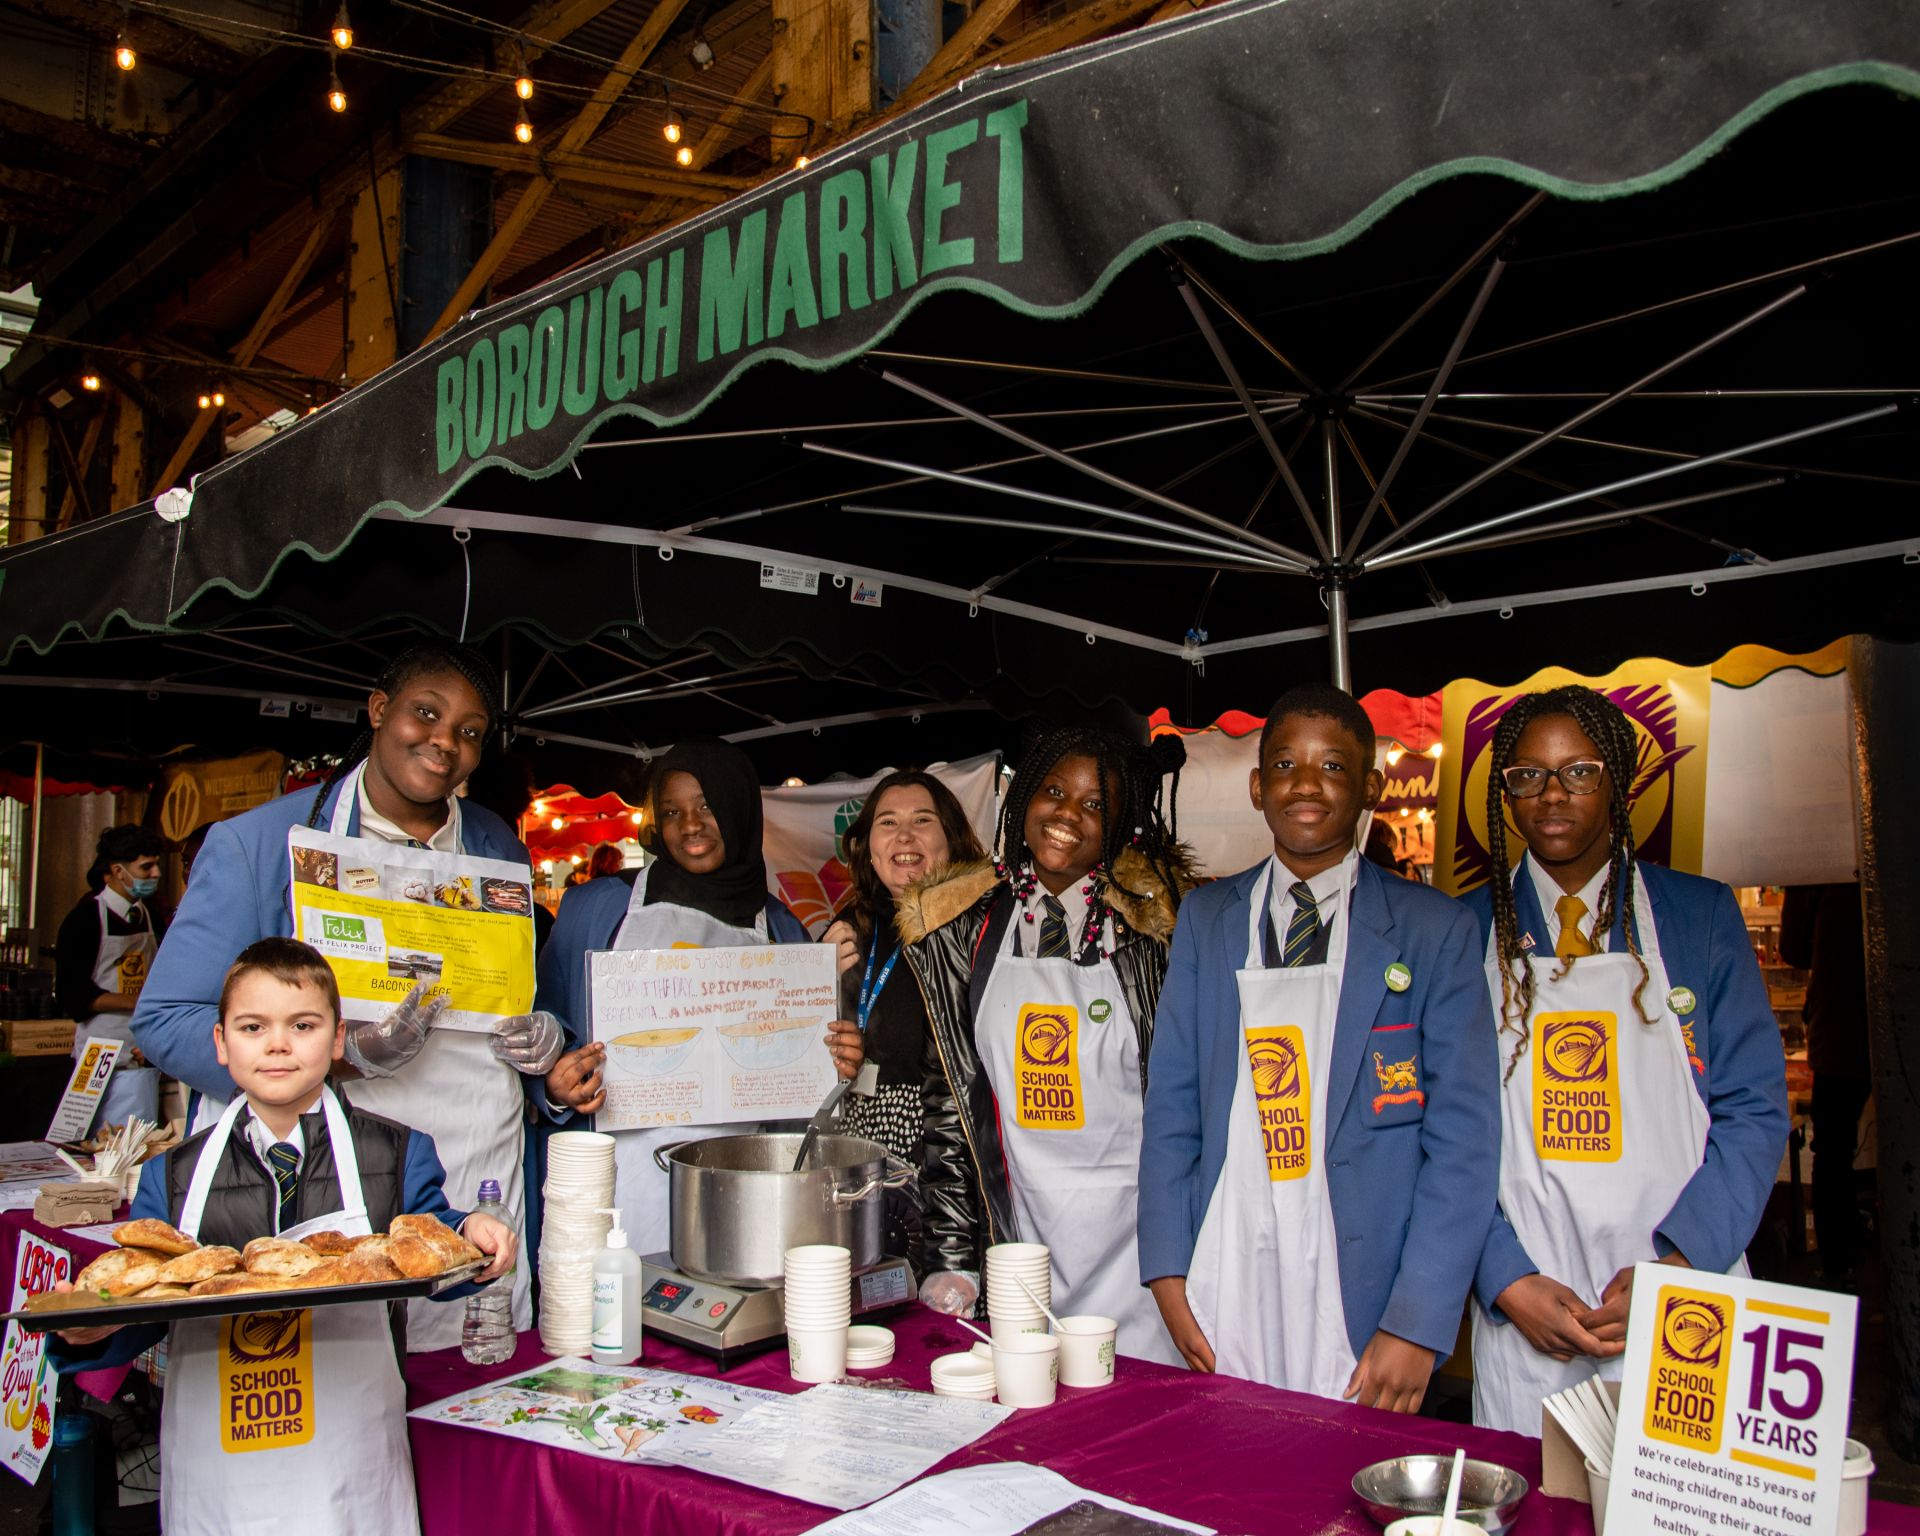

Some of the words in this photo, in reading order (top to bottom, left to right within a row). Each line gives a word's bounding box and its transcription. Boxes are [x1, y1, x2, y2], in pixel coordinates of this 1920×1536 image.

[437, 248, 684, 474] BOROUGH
[698, 100, 1028, 363] MARKET
[326, 917, 364, 939] Felix
[309, 937, 324, 945] THE
[326, 940, 348, 949] FELIX
[350, 943, 382, 953] PROJECT
[371, 978, 412, 993] BACONS
[94, 1052, 115, 1079] 15
[1021, 1071, 1073, 1087] SCHOOL
[1022, 1087, 1075, 1109] FOOD
[1542, 1089, 1611, 1108] SCHOOL
[1023, 1109, 1076, 1121] MATTERS
[1259, 1106, 1304, 1127] HOOL
[1542, 1108, 1611, 1135] FOOD
[1262, 1126, 1305, 1154] OOD
[1542, 1134, 1611, 1152] MATTERS
[1267, 1152, 1305, 1171] TTERS
[3, 1357, 33, 1407] Day
[229, 1367, 302, 1392] SCHOOL
[1657, 1367, 1717, 1396] SCHOOL
[1742, 1323, 1825, 1422] 15
[230, 1388, 302, 1423] FOOD
[1654, 1387, 1715, 1424] FOOD
[231, 1417, 303, 1441] MATTERS
[1652, 1414, 1712, 1442] MATTERS
[1736, 1412, 1819, 1459] YEARS
[1638, 1444, 1671, 1465] We're
[1673, 1457, 1743, 1487] celebrating
[1745, 1474, 1760, 1489] 15
[1763, 1481, 1799, 1499] years
[1801, 1490, 1817, 1504] of
[1631, 1487, 1653, 1502] and
[1655, 1492, 1717, 1525] improving
[1719, 1512, 1751, 1533] their
[1634, 1466, 1685, 1493] teaching
[1687, 1480, 1738, 1505] children
[1740, 1496, 1778, 1518] about
[1781, 1506, 1812, 1527] food
